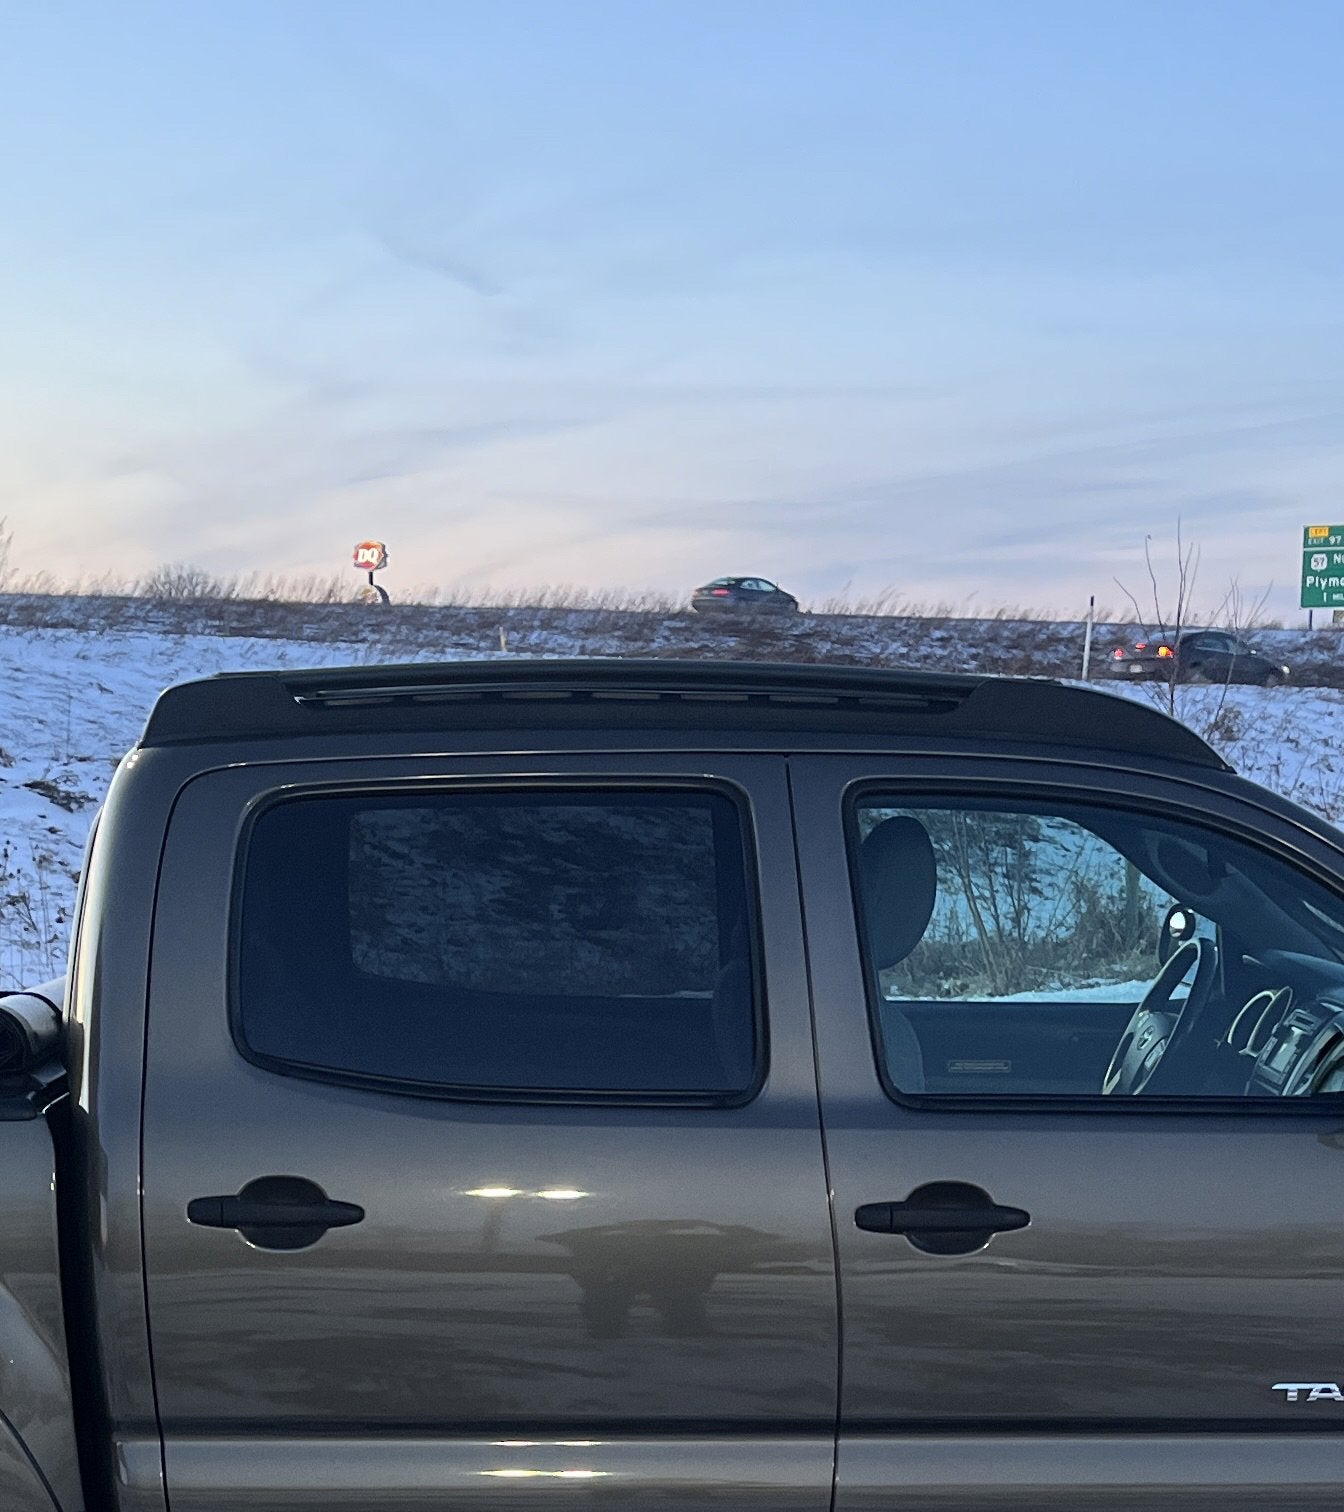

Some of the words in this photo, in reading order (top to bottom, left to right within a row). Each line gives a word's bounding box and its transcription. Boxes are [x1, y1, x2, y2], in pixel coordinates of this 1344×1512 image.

[1328, 535, 1342, 546] 97
[357, 547, 379, 564] DQ
[1313, 556, 1325, 567] 57
